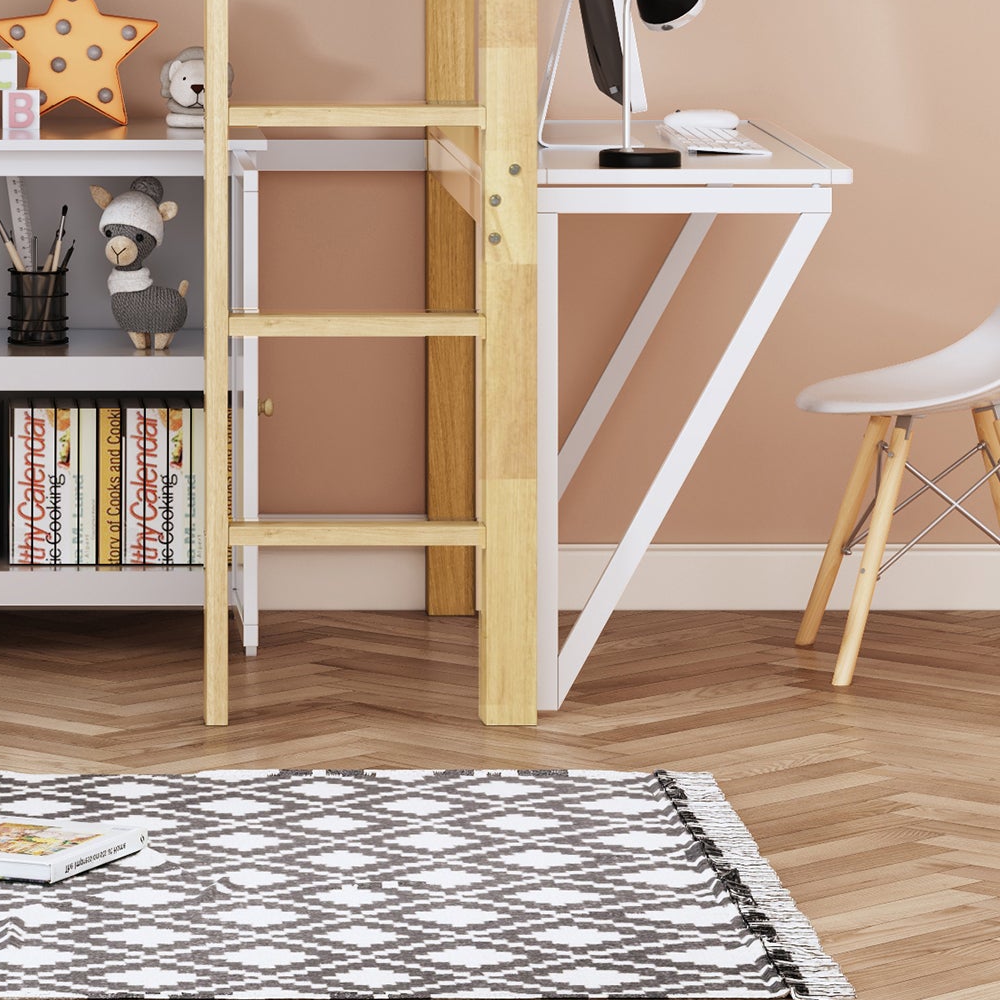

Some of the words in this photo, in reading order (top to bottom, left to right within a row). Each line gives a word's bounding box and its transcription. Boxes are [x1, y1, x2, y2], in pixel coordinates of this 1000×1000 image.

[8, 92, 35, 129] B
[16, 410, 46, 522] Calendar
[107, 449, 120, 472] and
[129, 410, 158, 522] Calendar
[46, 474, 66, 545] Cooking
[106, 476, 120, 516] Cooks
[158, 474, 178, 545] Cooking
[107, 520, 120, 532] of
